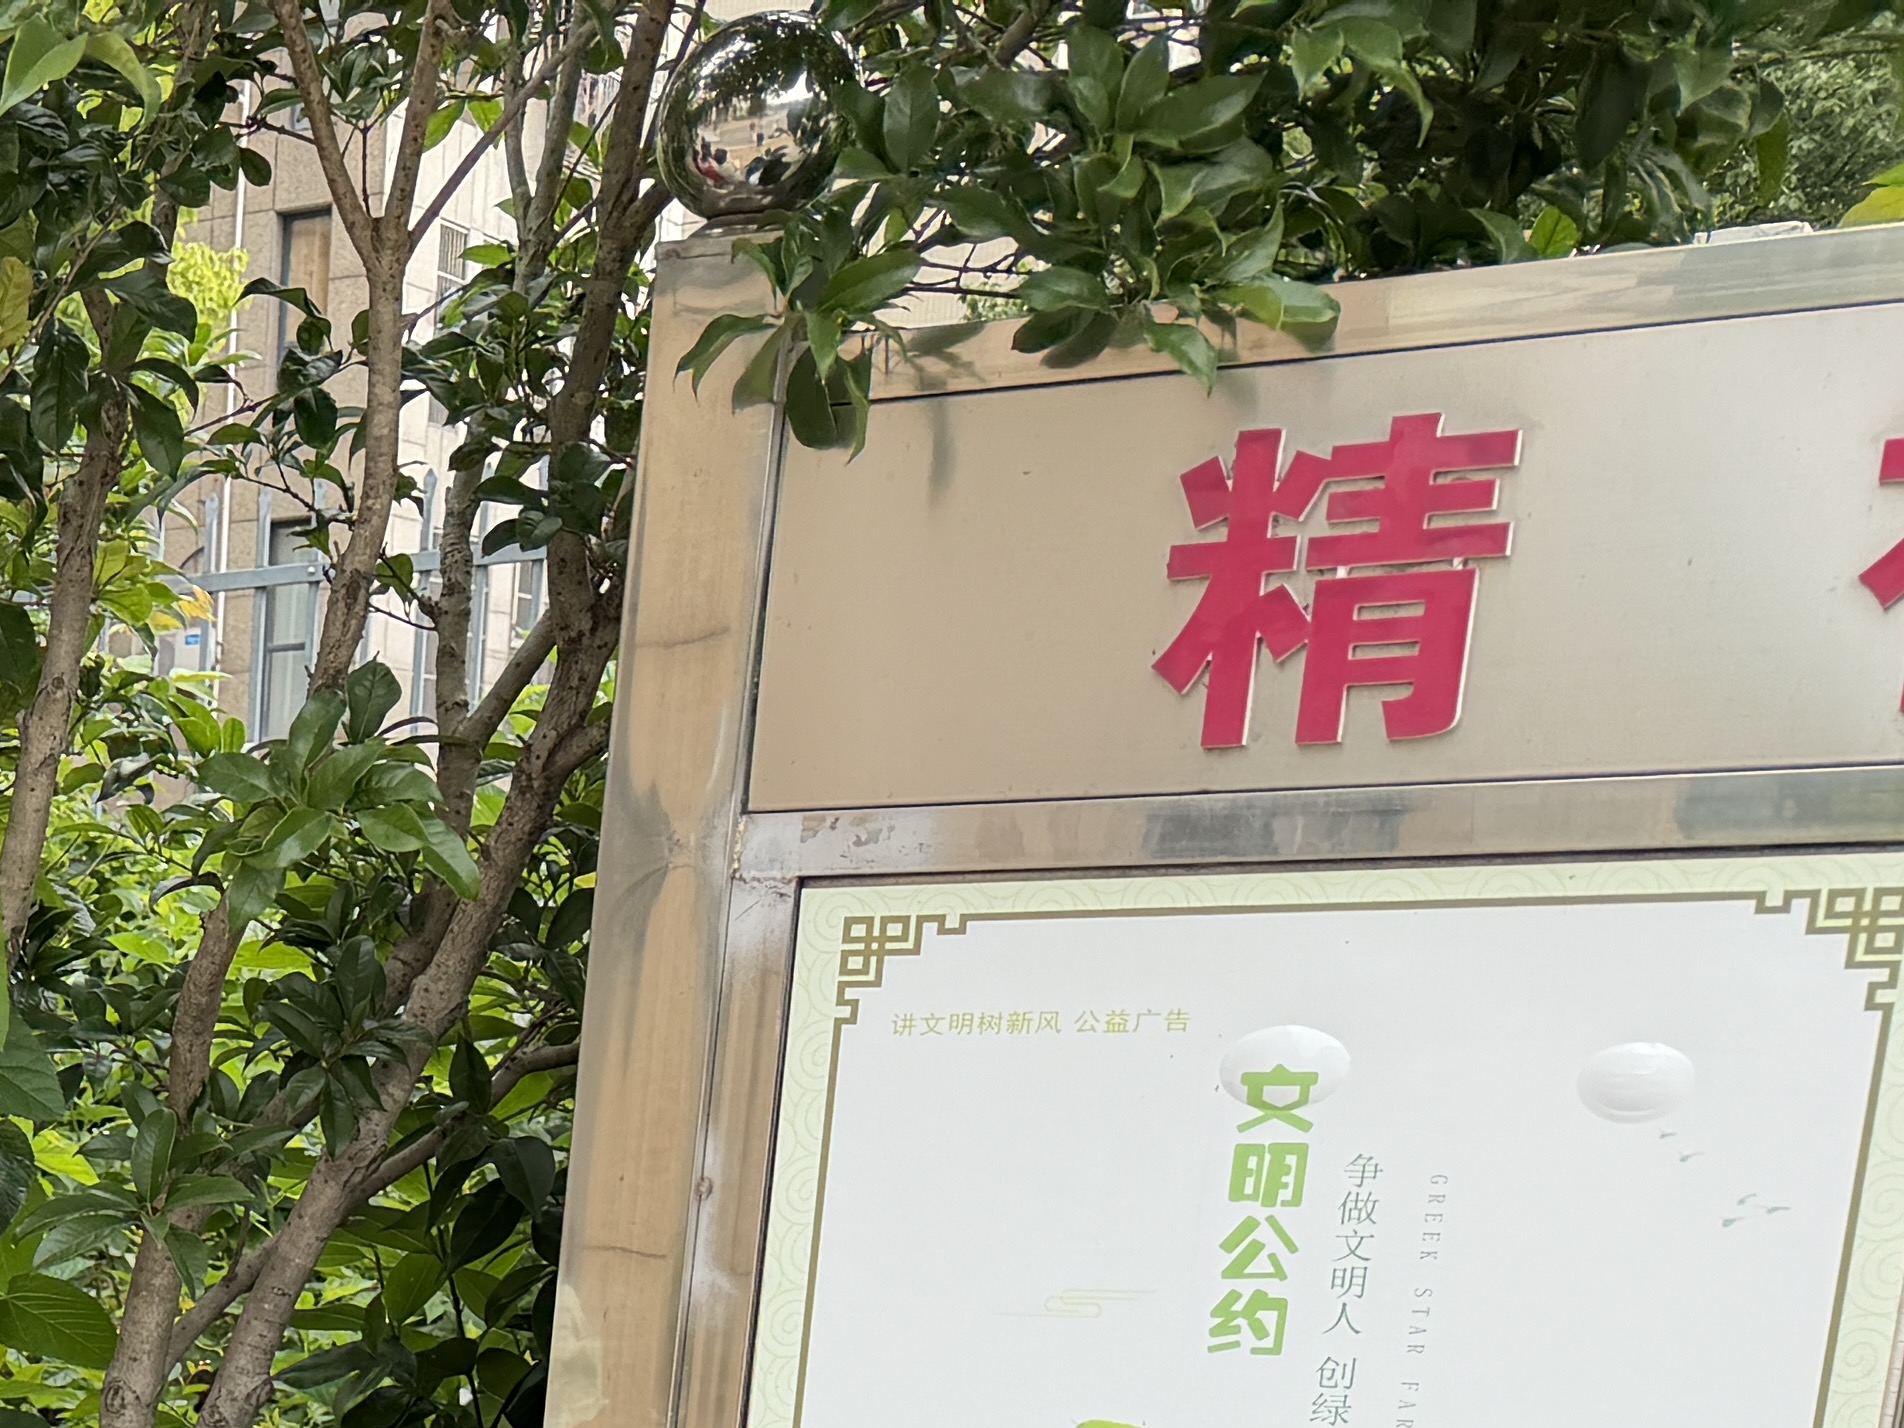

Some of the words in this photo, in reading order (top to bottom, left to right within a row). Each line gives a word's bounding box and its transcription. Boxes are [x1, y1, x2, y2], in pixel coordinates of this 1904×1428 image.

[1151, 411, 1524, 750] 精
[891, 1010, 1062, 1037] 讲文明树新风
[1074, 1008, 1191, 1035] 公益广告
[1206, 1063, 1320, 1357] 文明公约
[1321, 1152, 1385, 1337] 争做文明人
[1419, 1174, 1449, 1261] GREEK
[1406, 1287, 1434, 1355] STAR
